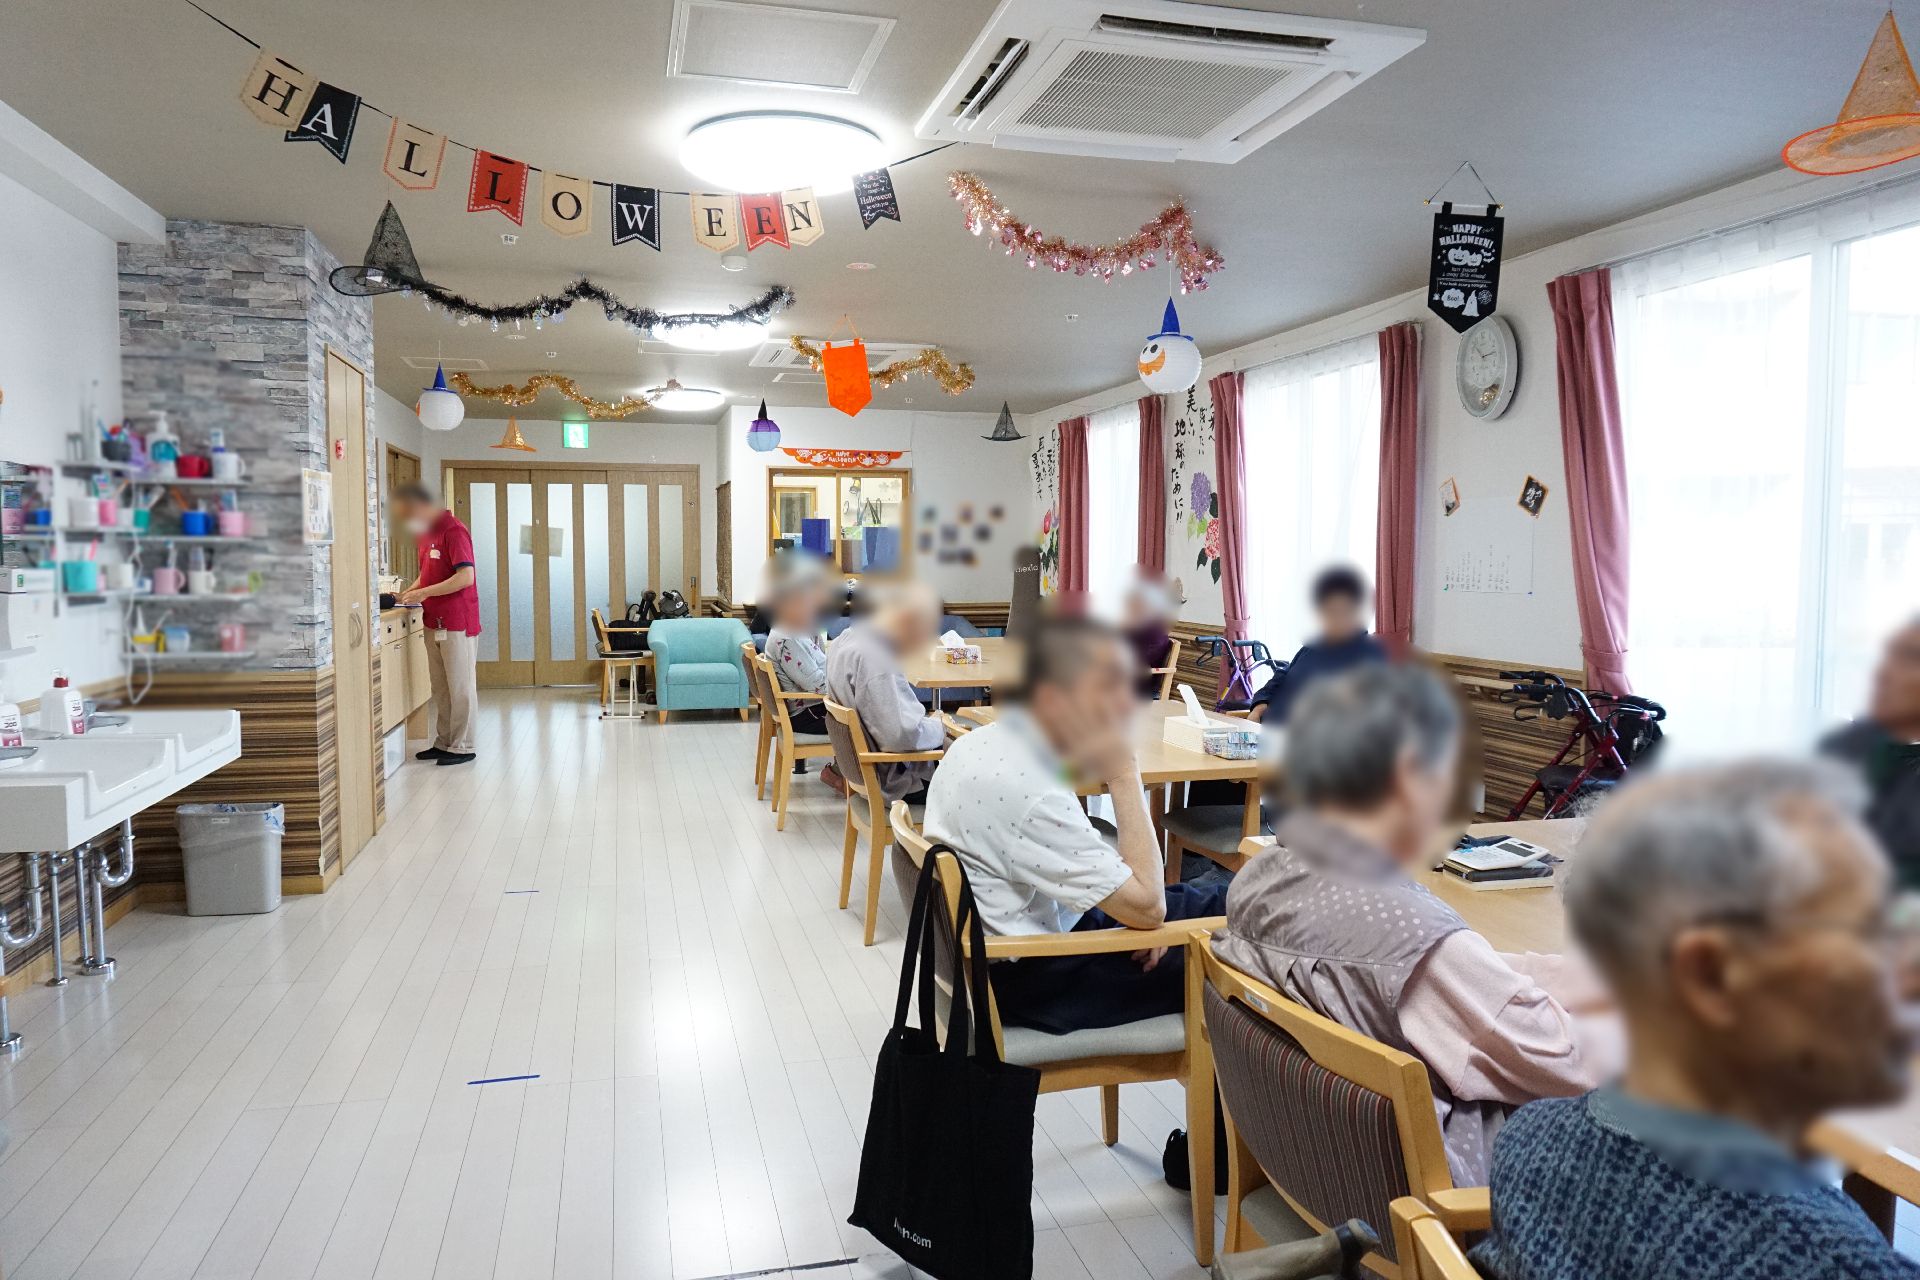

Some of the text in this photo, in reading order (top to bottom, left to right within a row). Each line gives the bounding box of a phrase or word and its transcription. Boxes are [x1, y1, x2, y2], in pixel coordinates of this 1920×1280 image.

[860, 192, 893, 205] Halloween
[1452, 223, 1483, 235] HAPPY
[1439, 234, 1494, 249] HALLOWEEN!
